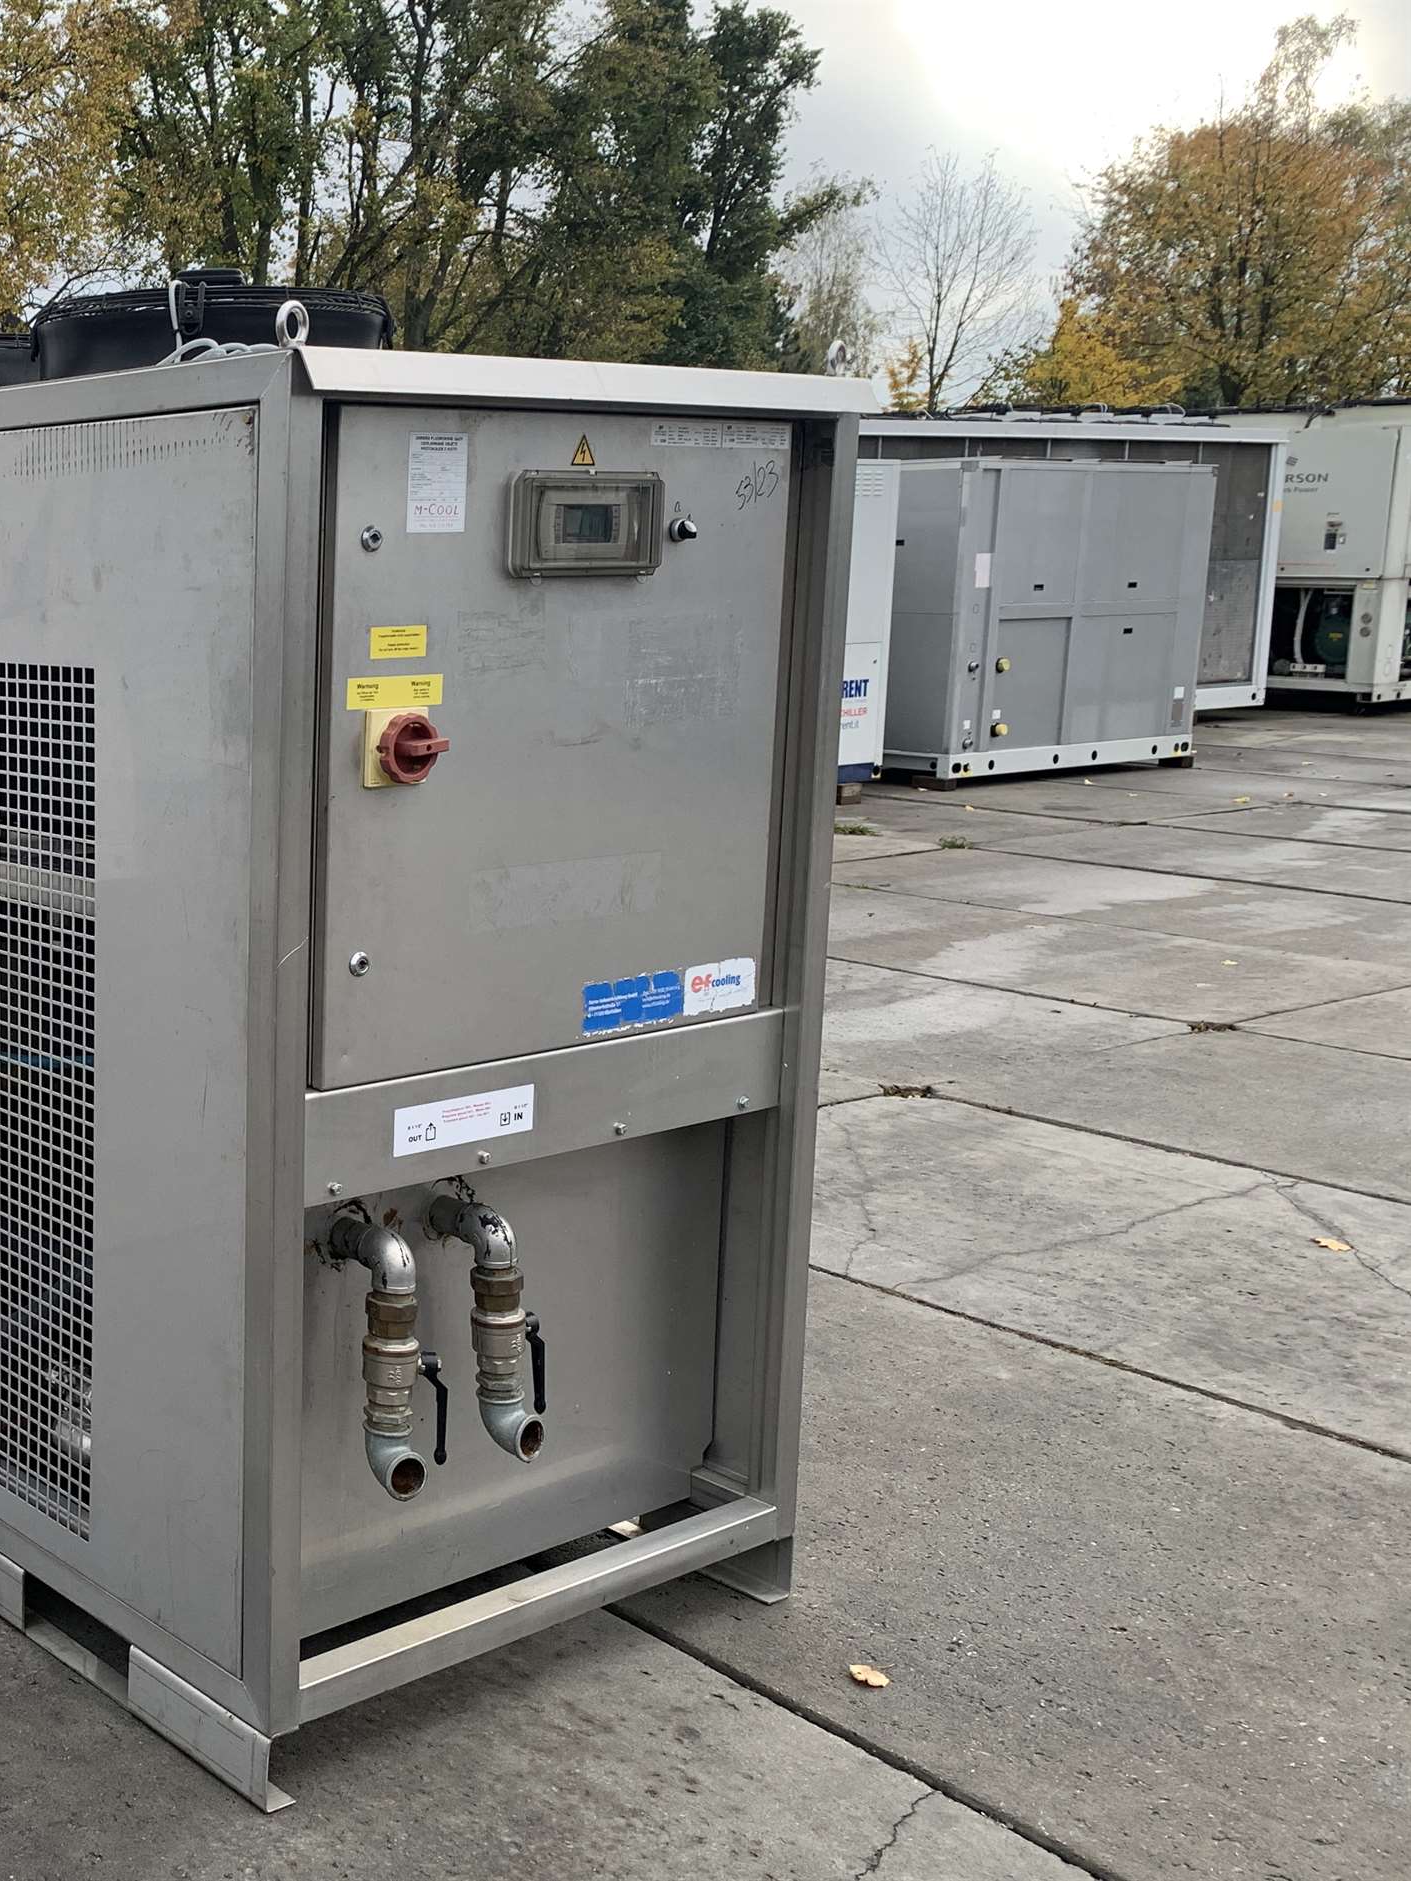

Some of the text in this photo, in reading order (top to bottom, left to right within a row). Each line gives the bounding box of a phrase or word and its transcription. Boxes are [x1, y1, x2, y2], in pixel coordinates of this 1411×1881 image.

[1284, 473, 1329, 483] RSON
[413, 503, 460, 516] M-COOL
[842, 679, 869, 698] RENT
[839, 707, 867, 717] HILLER
[514, 1112, 523, 1121] IN
[408, 1134, 423, 1143] OUT
